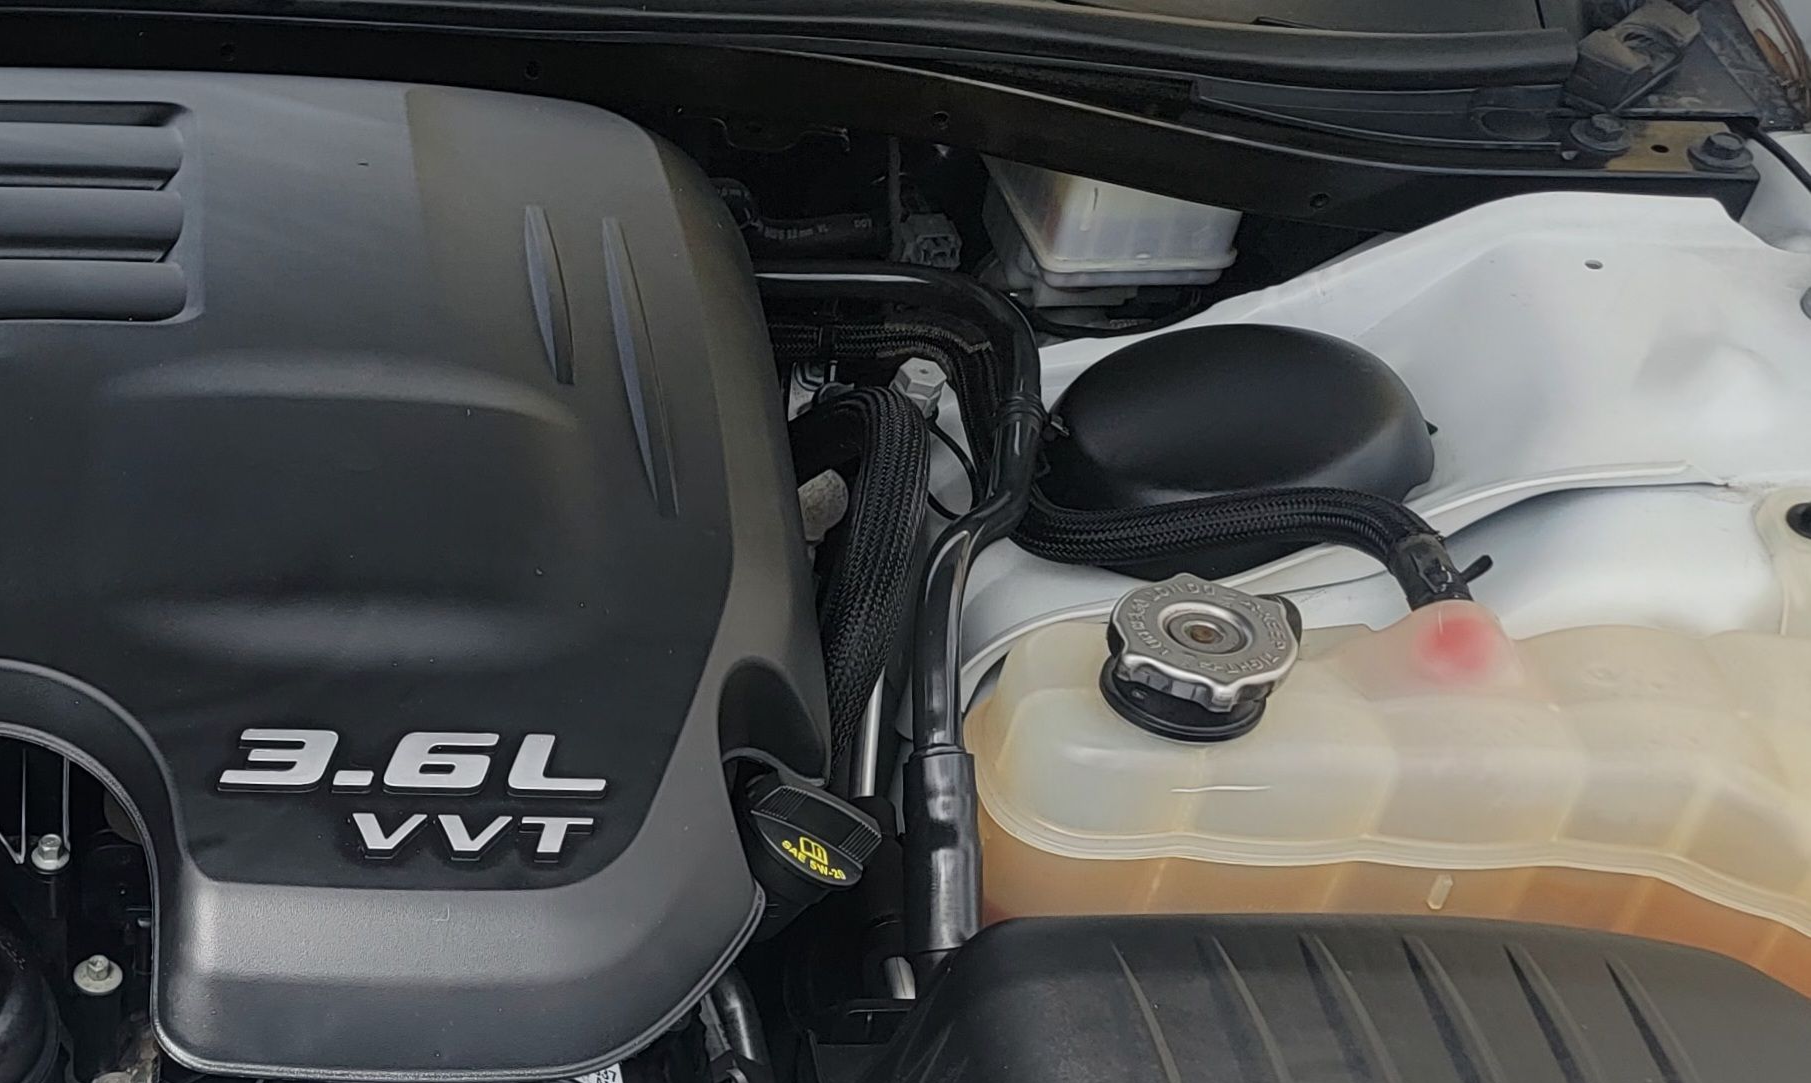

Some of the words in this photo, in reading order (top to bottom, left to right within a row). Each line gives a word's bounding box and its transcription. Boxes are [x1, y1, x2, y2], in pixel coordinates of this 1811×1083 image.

[1223, 650, 1281, 675] TIGHT
[218, 728, 607, 796] 3.6L
[351, 812, 594, 861] VVT
[782, 840, 806, 863] SAE
[810, 860, 846, 880] 5W-20
